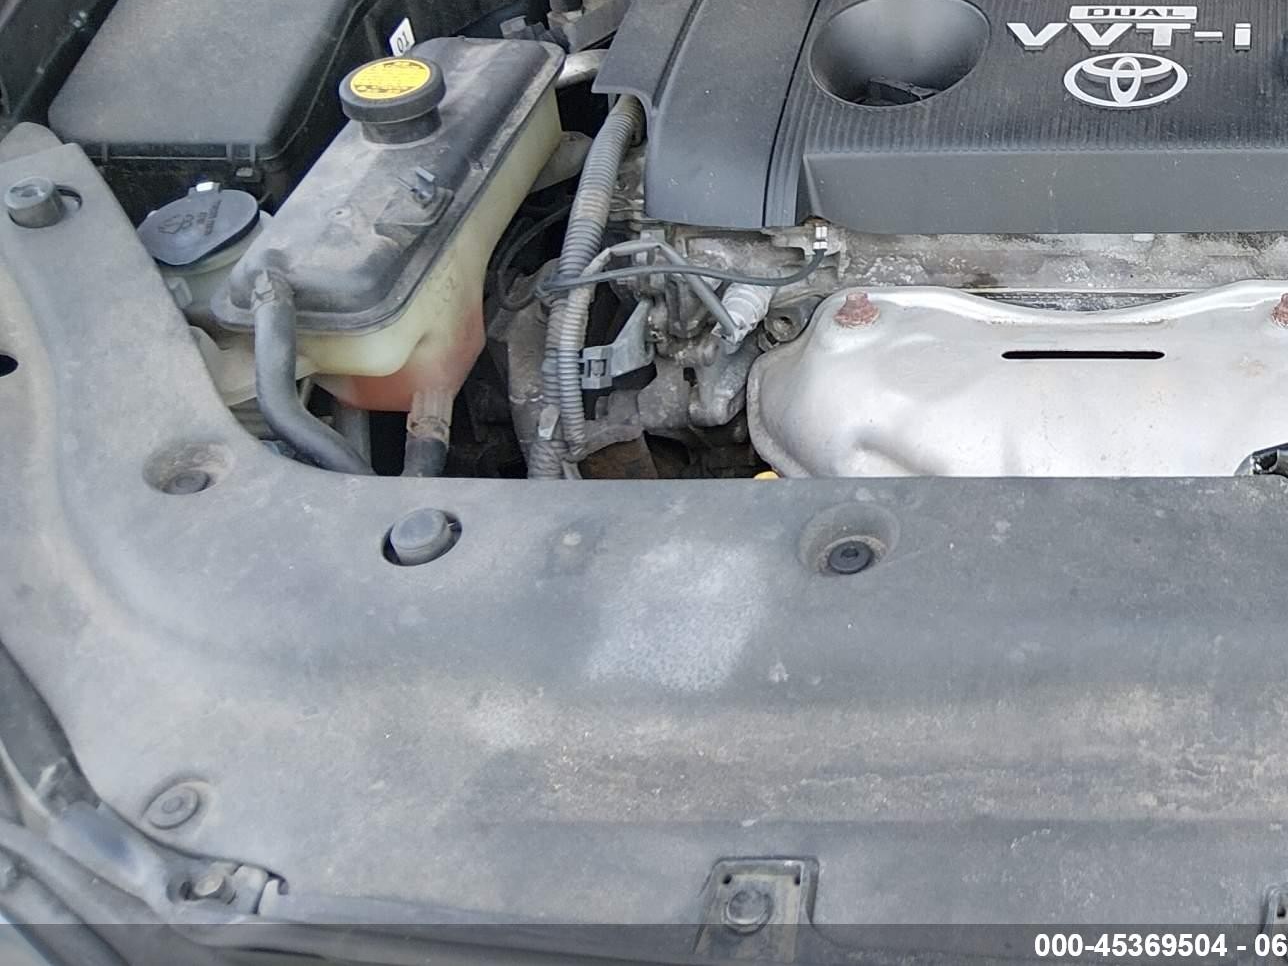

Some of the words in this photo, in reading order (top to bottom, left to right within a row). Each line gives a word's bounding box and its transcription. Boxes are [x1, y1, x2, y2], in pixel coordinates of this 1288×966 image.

[1087, 8, 1186, 17] DUAL
[396, 31, 410, 53] 01
[1006, 22, 1251, 49] VVT-i
